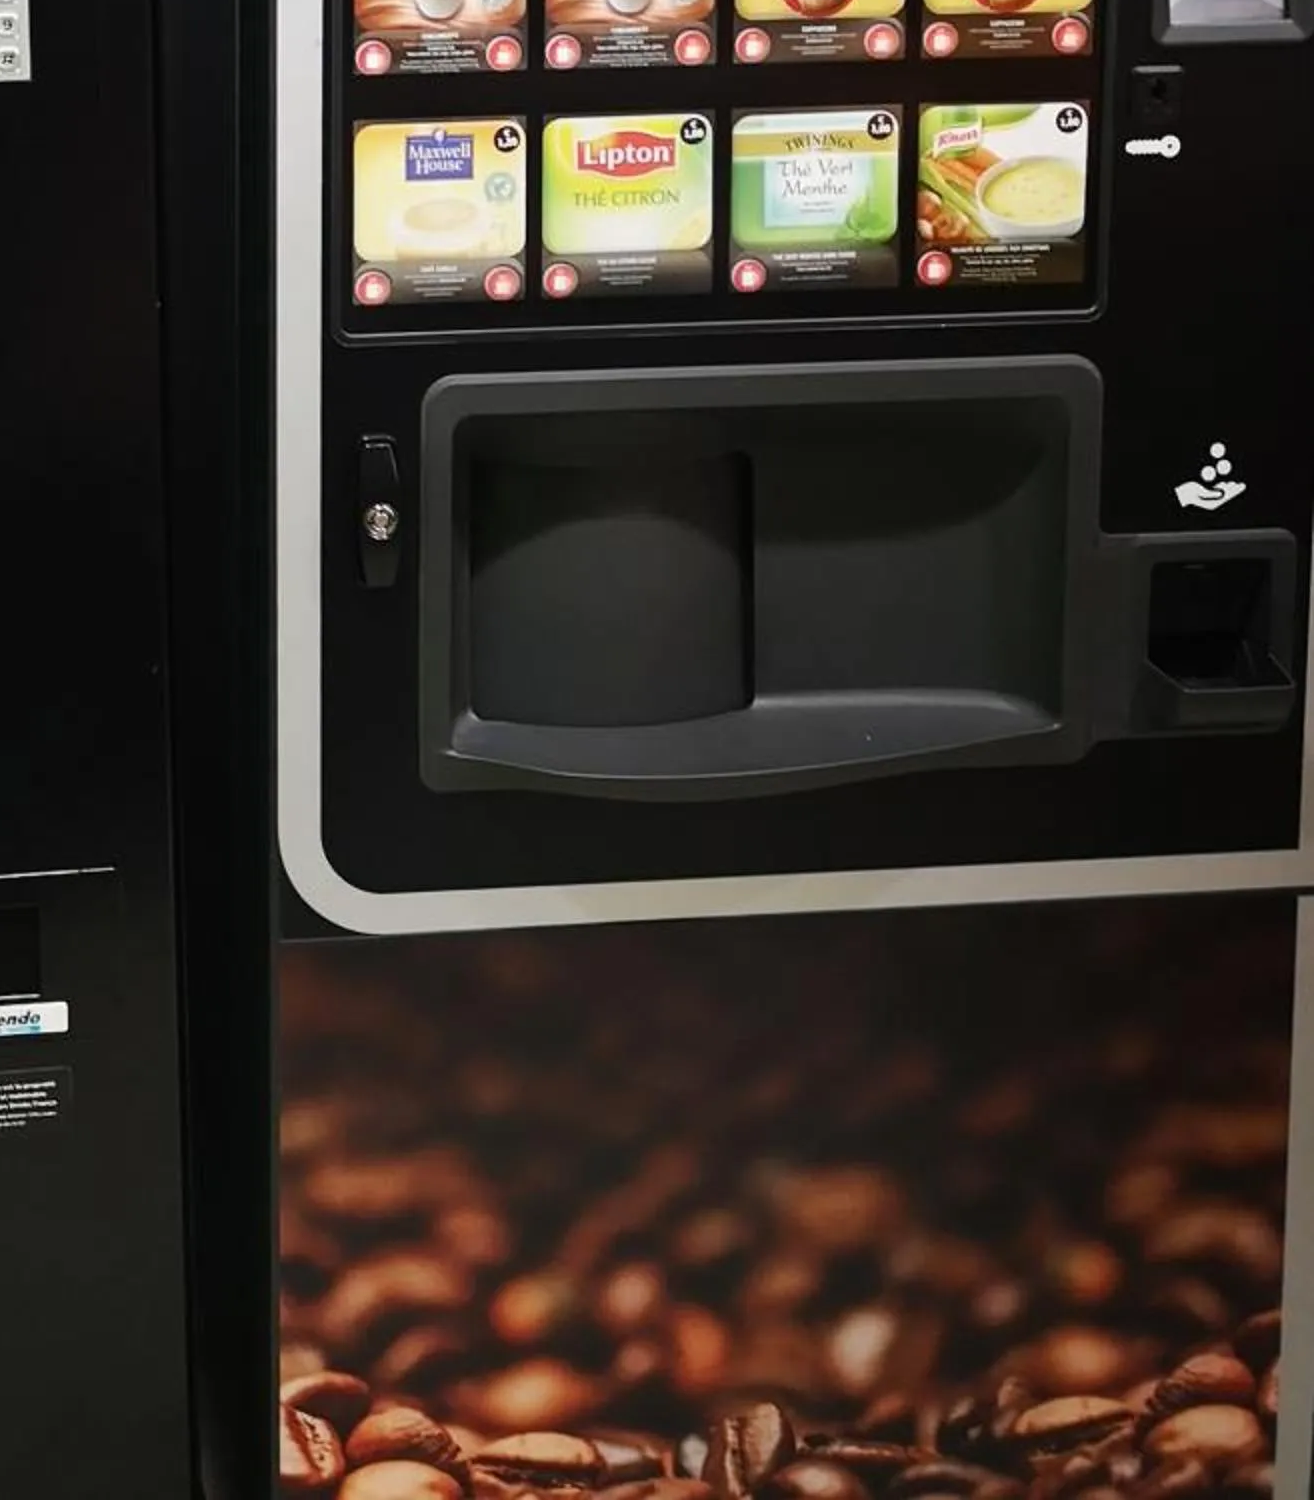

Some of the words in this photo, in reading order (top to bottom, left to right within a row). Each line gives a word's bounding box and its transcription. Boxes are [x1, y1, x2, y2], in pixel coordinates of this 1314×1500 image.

[408, 143, 471, 159] Maxwell
[584, 143, 671, 170] Lipton
[415, 159, 464, 175] House
[817, 158, 853, 173] Vert
[782, 178, 847, 197] Menthe
[611, 190, 680, 206] CITRON
